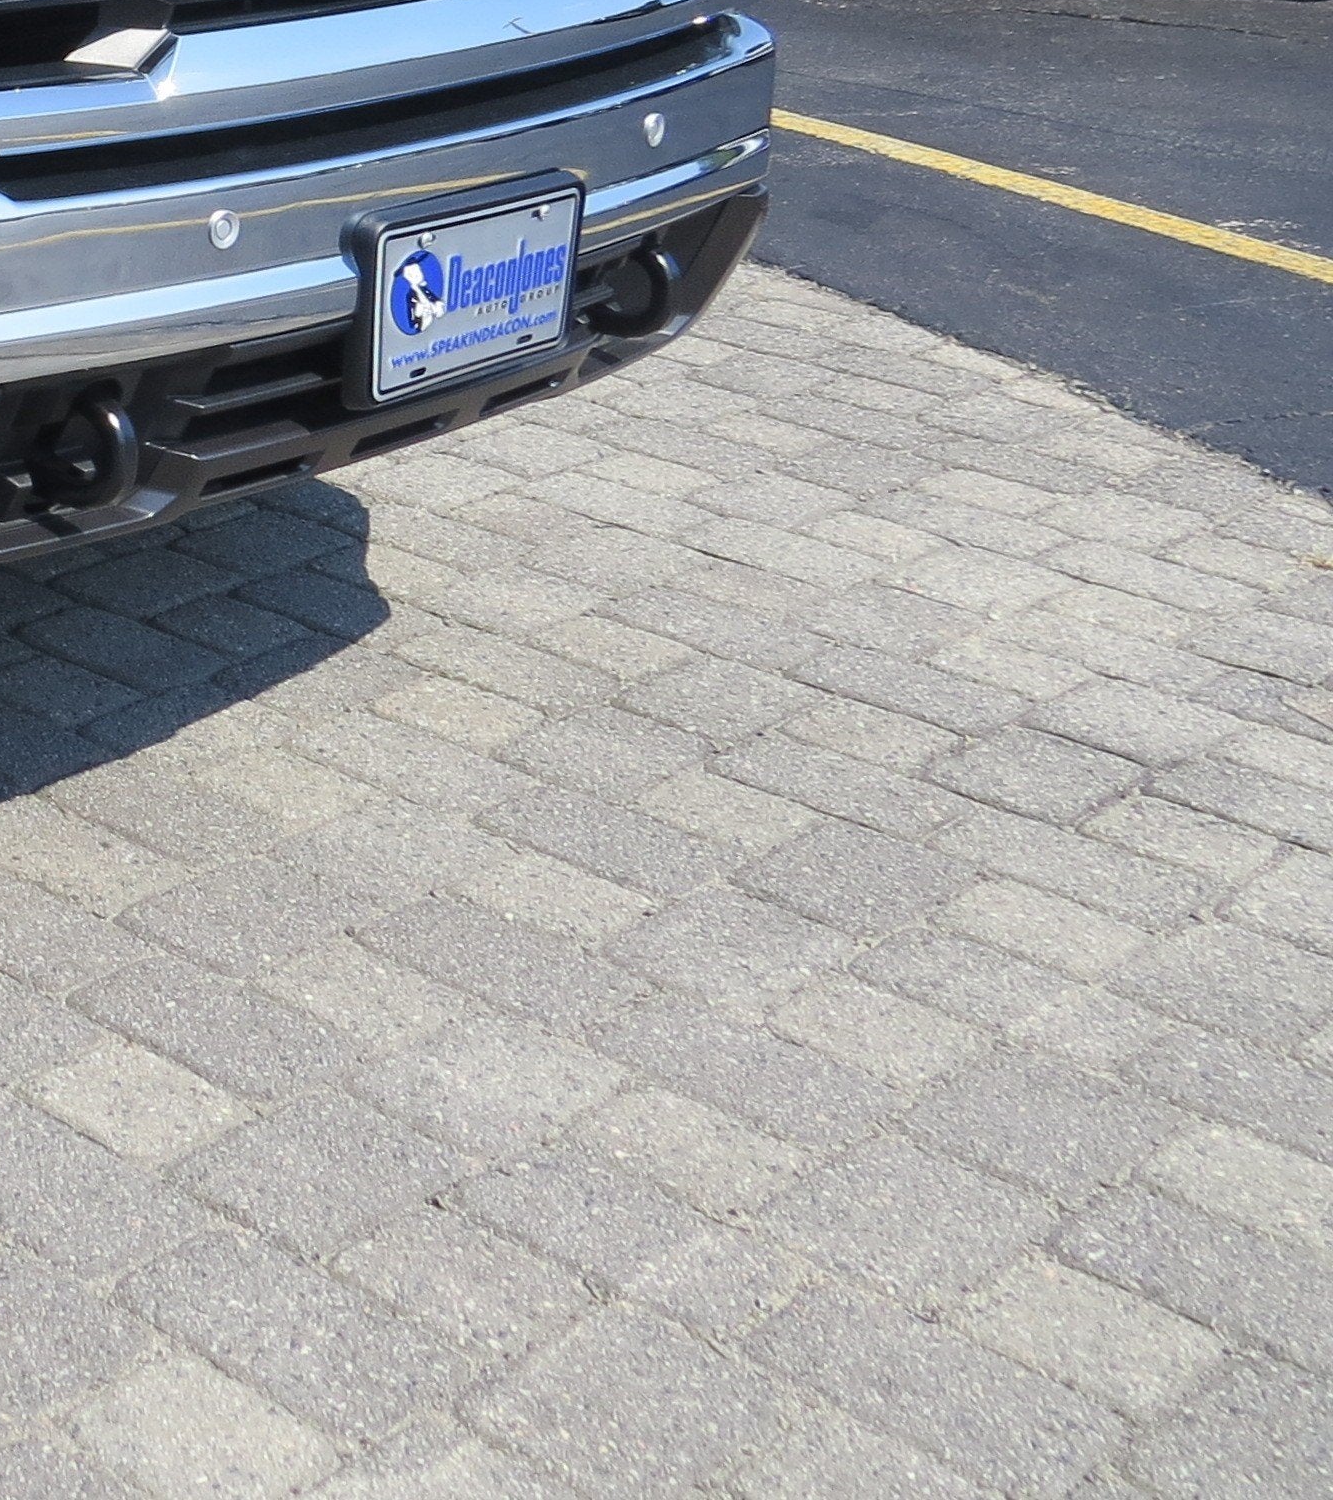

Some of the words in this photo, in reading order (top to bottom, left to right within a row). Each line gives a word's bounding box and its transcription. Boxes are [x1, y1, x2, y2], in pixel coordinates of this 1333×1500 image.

[476, 300, 508, 316] AUTO
[520, 285, 561, 303] GROUP
[391, 310, 558, 369] www.SPEAKINDEACON.com
